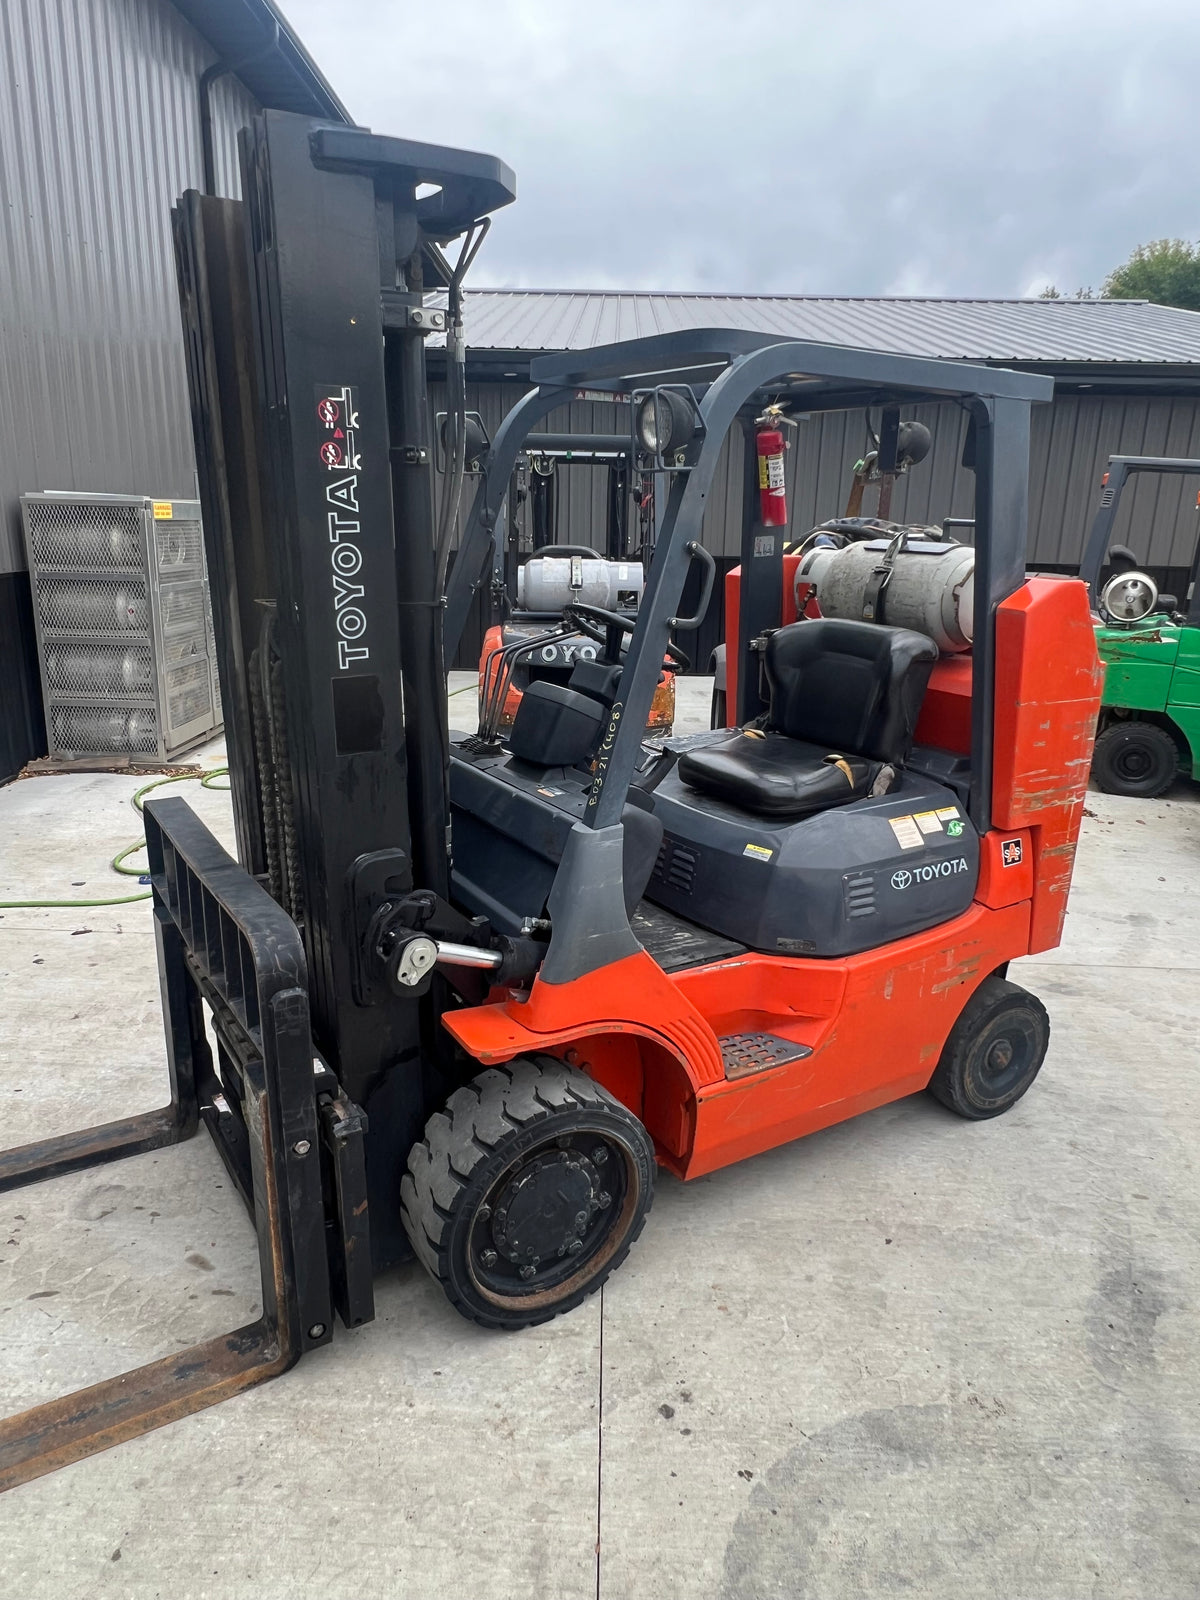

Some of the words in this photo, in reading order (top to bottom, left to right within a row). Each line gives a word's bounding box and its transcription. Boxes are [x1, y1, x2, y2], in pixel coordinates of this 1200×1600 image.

[326, 474, 369, 670] TOYOTA
[526, 645, 598, 662] OYO
[1004, 843, 1021, 863] SAS
[913, 858, 969, 883] TOYOTA
